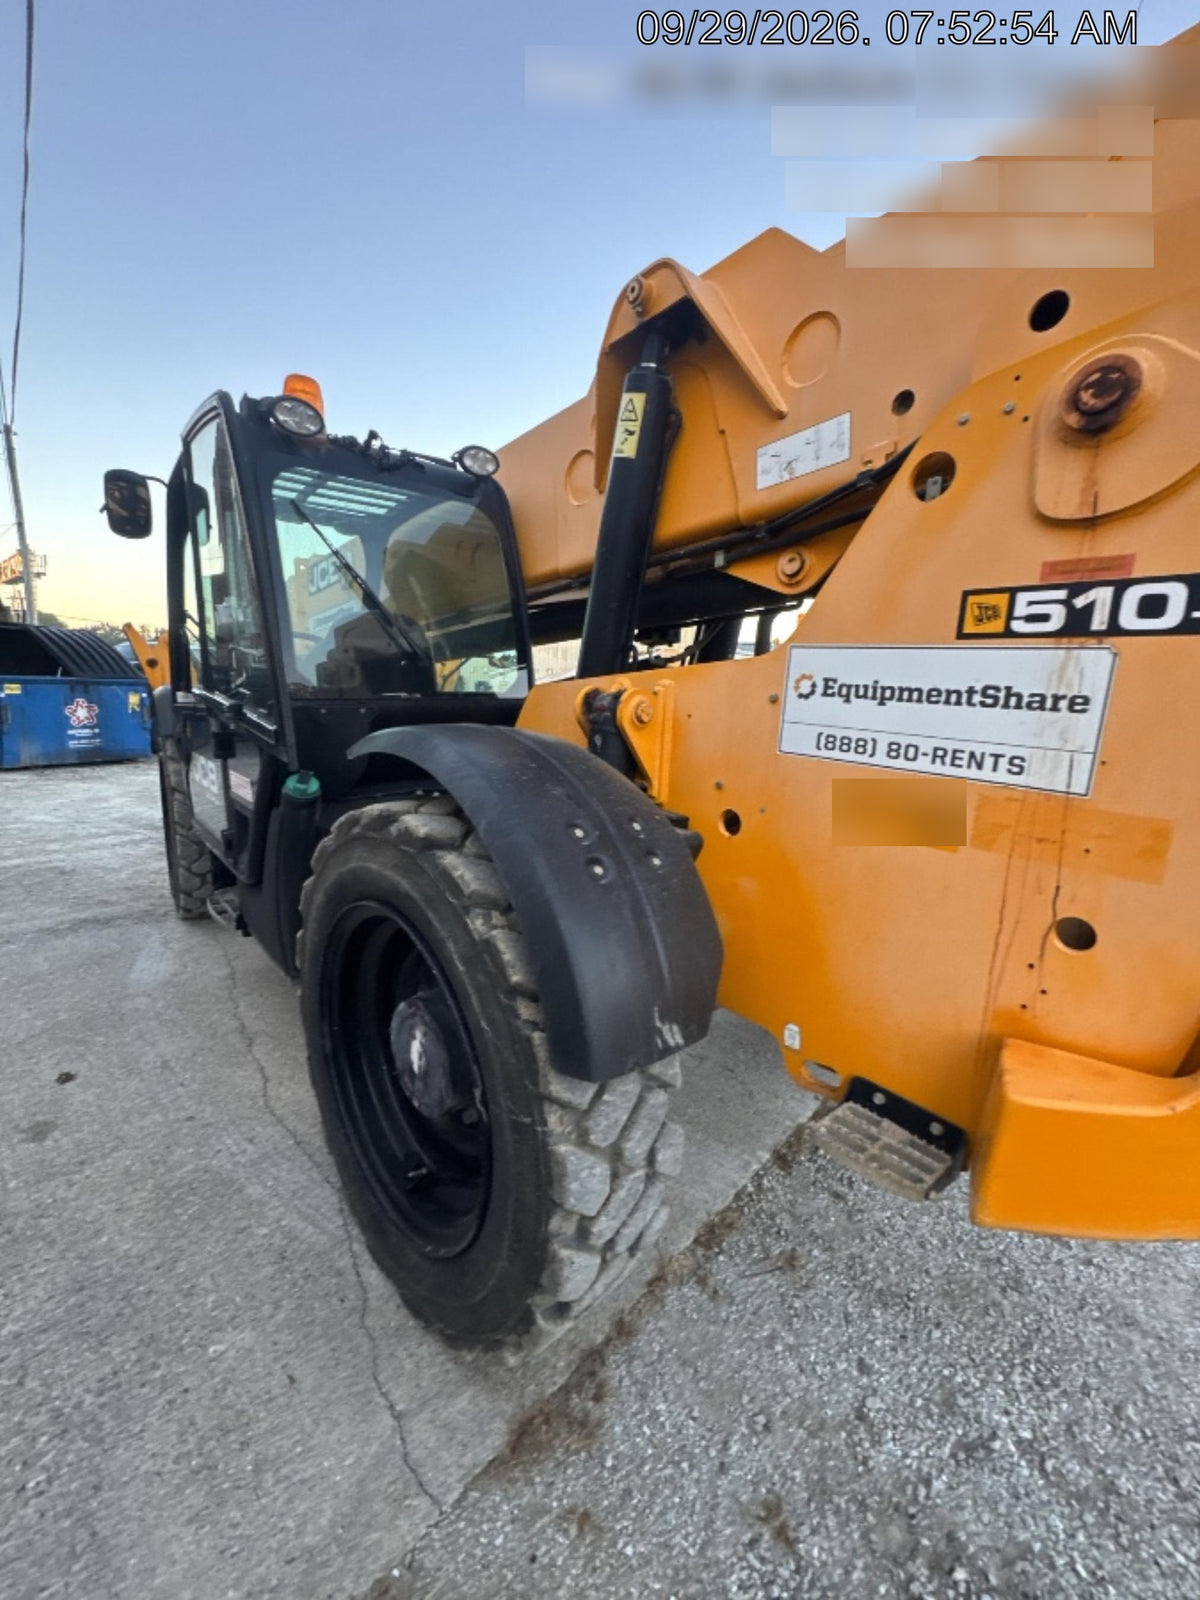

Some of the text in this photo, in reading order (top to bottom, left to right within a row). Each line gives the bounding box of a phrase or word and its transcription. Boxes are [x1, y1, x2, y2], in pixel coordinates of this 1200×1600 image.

[974, 603, 1000, 625] JCB
[820, 676, 1091, 714] EquipmentShare
[815, 731, 1027, 776] (888) 80-RENTS
